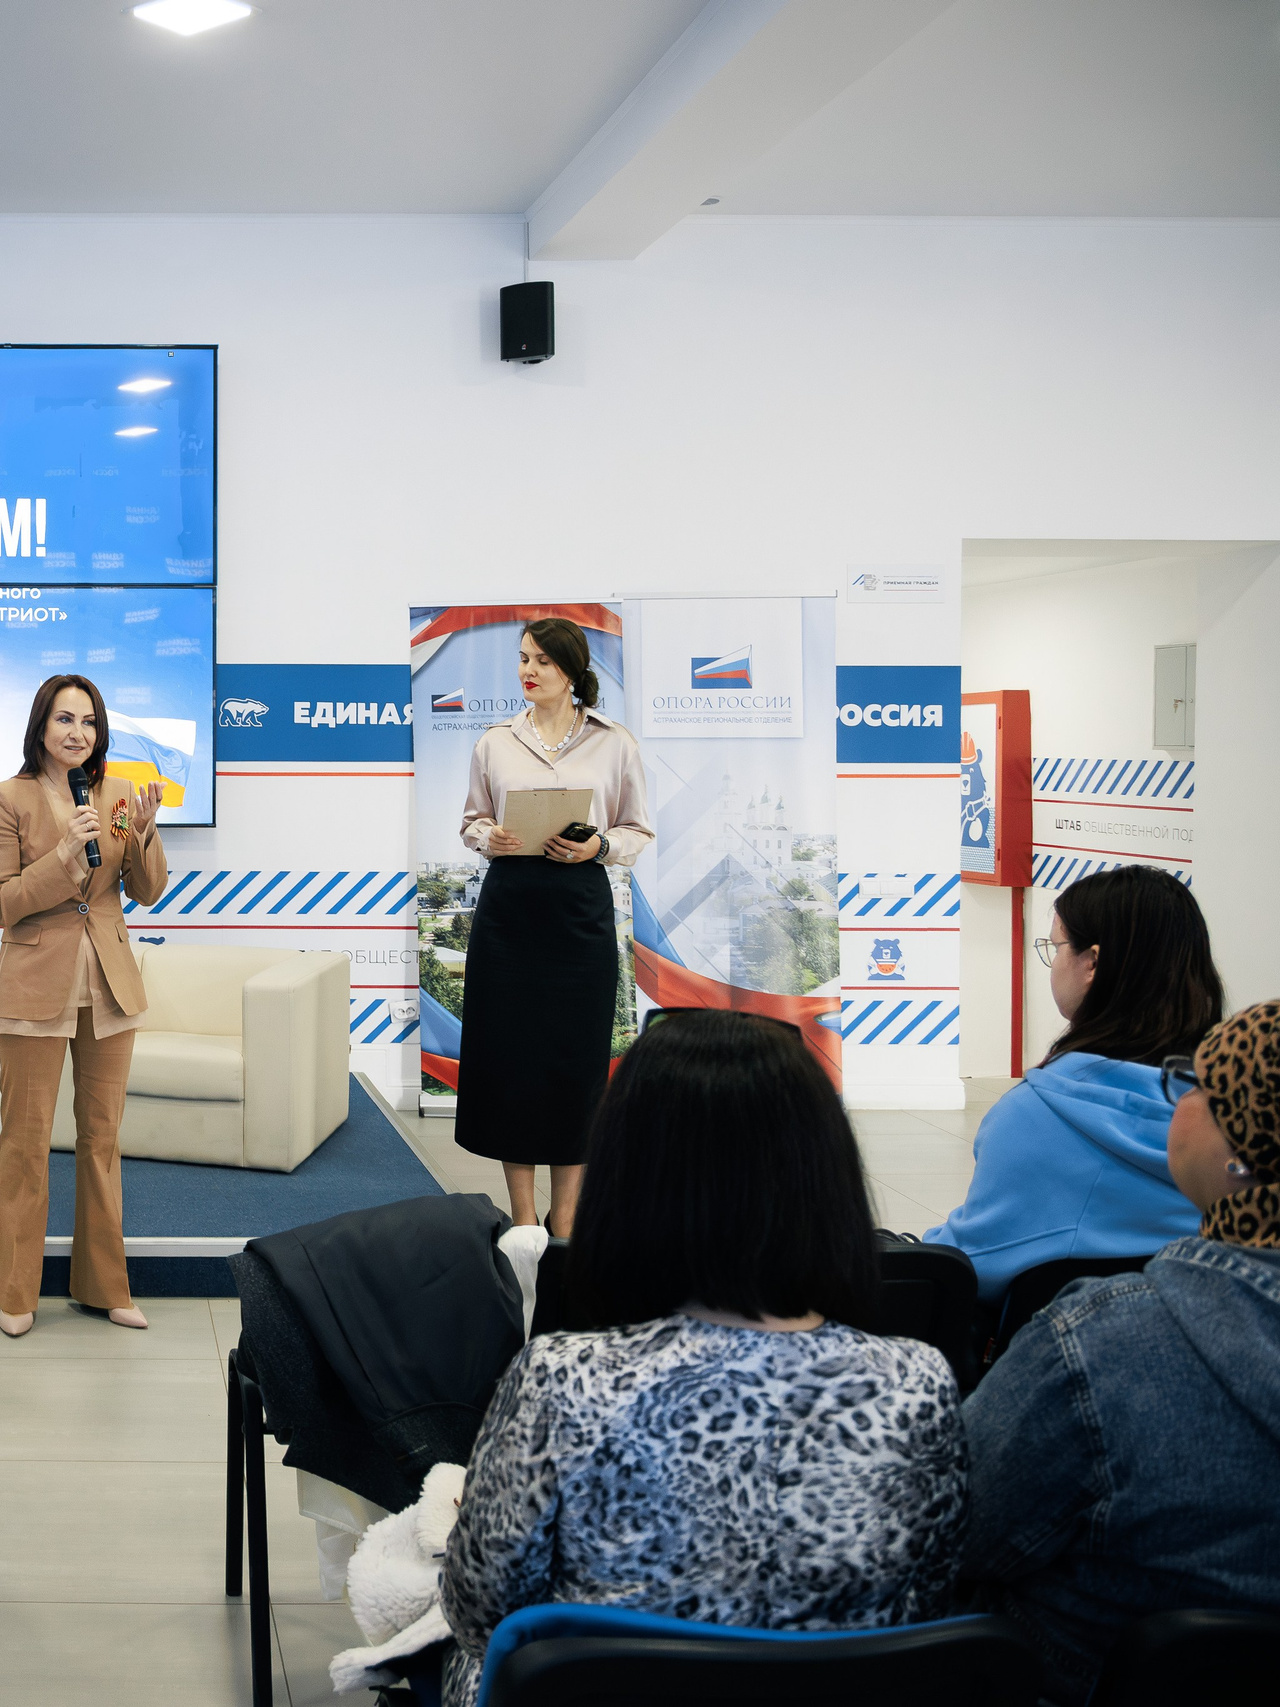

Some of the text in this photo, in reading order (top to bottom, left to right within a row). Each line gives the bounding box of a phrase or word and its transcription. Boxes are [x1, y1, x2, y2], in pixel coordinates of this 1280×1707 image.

[469, 698, 528, 712] ОПОРА
[652, 696, 791, 709] ОПОРА РОССИИ
[294, 702, 413, 728] ЕДИНАЯ
[1055, 818, 1081, 831] ШТАБ
[1084, 821, 1169, 839] ОБЩЕСТВЕННОЙ
